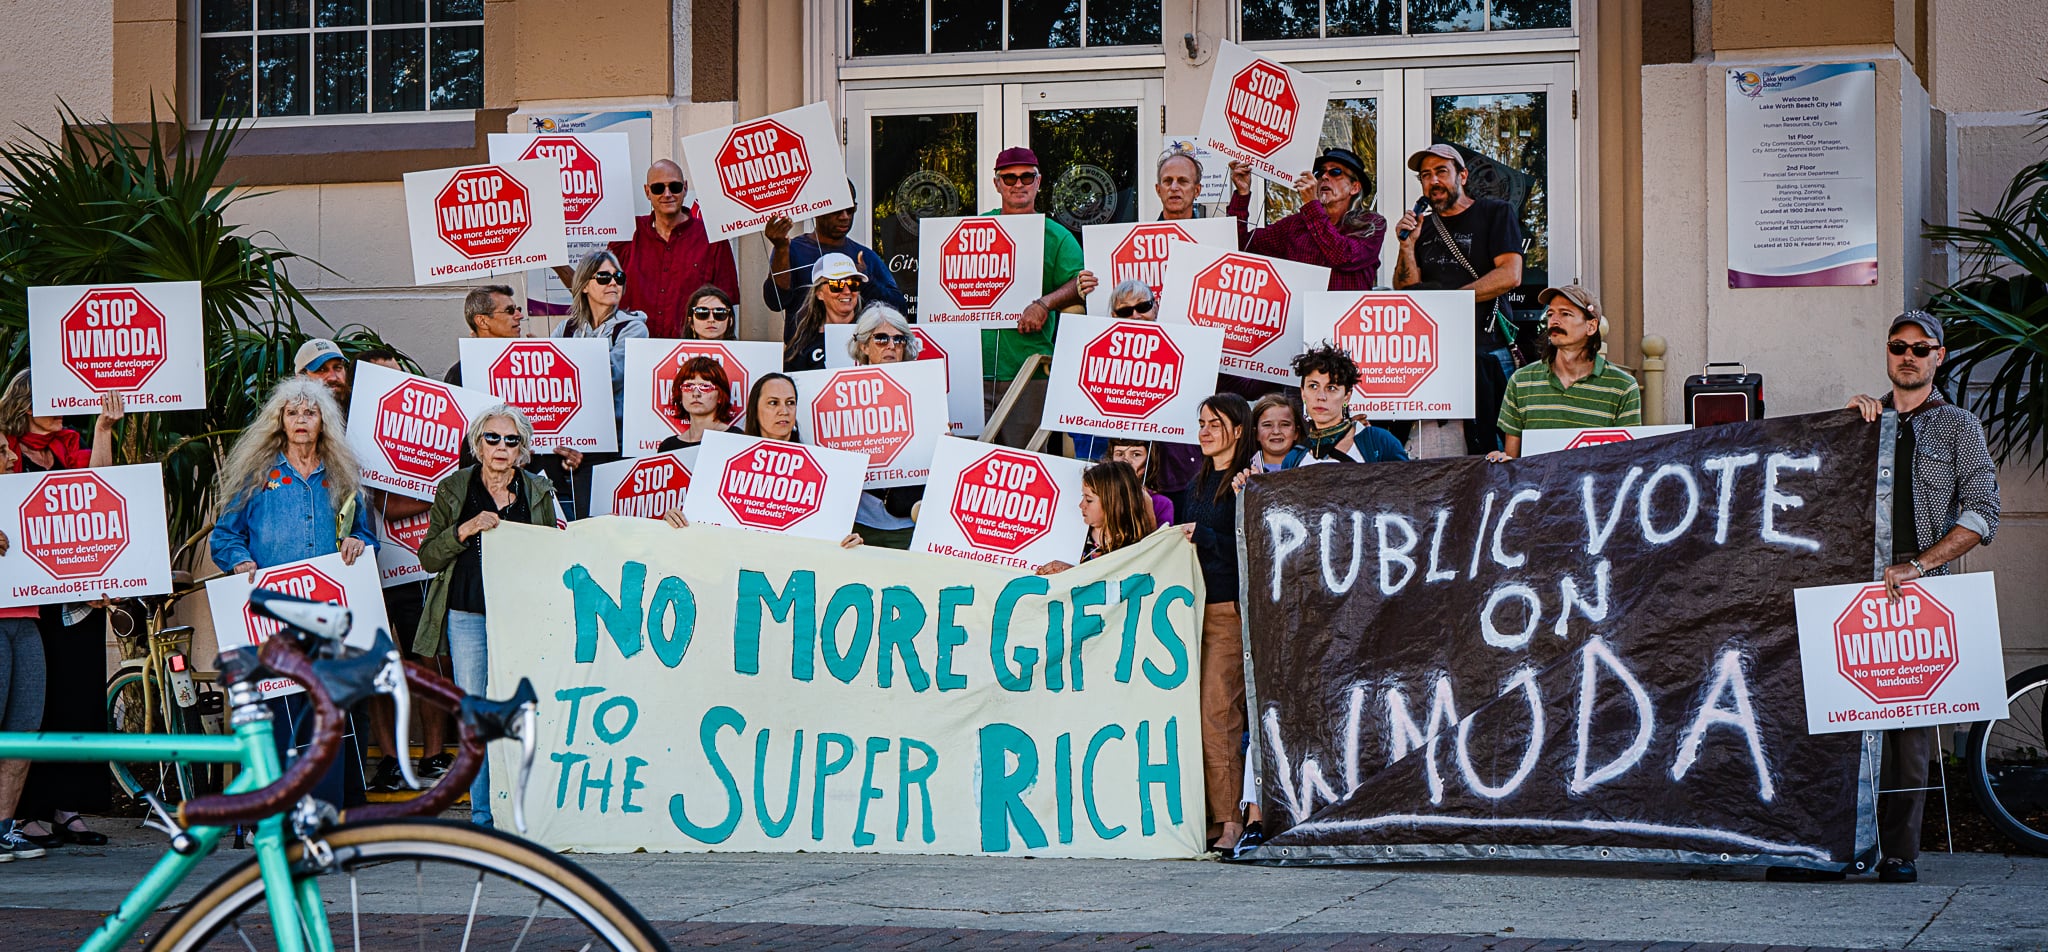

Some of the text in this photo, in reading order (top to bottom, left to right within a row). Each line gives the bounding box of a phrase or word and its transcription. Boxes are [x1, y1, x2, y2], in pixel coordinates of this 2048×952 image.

[1249, 68, 1285, 101] STOP
[1231, 87, 1292, 135] WMODA
[733, 128, 778, 160] STOP
[723, 148, 805, 189] WMODA
[457, 175, 503, 202] STOP
[442, 198, 526, 230] WMODA
[451, 232, 463, 240] No
[485, 226, 522, 236] developer
[469, 234, 505, 246] handouts!
[958, 227, 996, 253] STOP
[431, 253, 547, 276] LWBcandoBETTER.com
[945, 253, 1011, 280] WMODA
[962, 289, 991, 297] handouts!
[976, 281, 1006, 290] developer
[1218, 263, 1268, 295] STOP
[85, 298, 137, 327] STOP
[1198, 287, 1281, 328] WMODA
[1359, 306, 1410, 333] STOP
[68, 327, 160, 358] WMODA
[1108, 332, 1159, 359] STOP
[76, 361, 88, 369] No
[114, 359, 155, 369] developer
[95, 368, 135, 377] handouts!
[510, 351, 554, 376] STOP
[1088, 357, 1173, 389] WMODA
[1385, 366, 1426, 376] developer
[495, 377, 575, 403] WMODA
[1089, 384, 1165, 401] No more developer
[1366, 375, 1406, 383] handouts!
[401, 388, 447, 420] STOP
[836, 378, 884, 409] STOP
[1105, 394, 1145, 405] handouts!
[383, 410, 459, 454] WMODA
[820, 404, 907, 440] WMODA
[1059, 414, 1185, 436] LWBcandoBETTER.com
[751, 449, 804, 477] STOP
[984, 460, 1036, 491] STOP
[634, 464, 674, 493] STOP
[729, 470, 816, 505] WMODA
[45, 482, 97, 511] STOP
[730, 496, 806, 515] No more developer
[961, 483, 1048, 525] WMODA
[746, 505, 785, 518] handouts!
[962, 512, 1038, 537] No more developer
[28, 510, 123, 543] WMODA
[977, 524, 1017, 539] handouts!
[1265, 452, 1820, 602] PUBLIC VOTE
[37, 543, 118, 554] No more developer
[57, 552, 98, 563] handouts!
[12, 576, 148, 598] LWBcandoBETTER.com
[1481, 560, 1610, 649] ON
[1861, 595, 1920, 629] STOP
[563, 561, 1195, 693] NO MORE GIFTS
[1843, 626, 1951, 665] WMODA
[1854, 663, 1946, 677] No more developer
[1877, 673, 1923, 686] handouts!
[555, 686, 638, 746] TO
[1828, 701, 1980, 723] LWBcandoBETTER.com
[1263, 638, 1776, 823] WMODA
[550, 751, 649, 814] THE
[669, 705, 1183, 852] SUPER RICH
